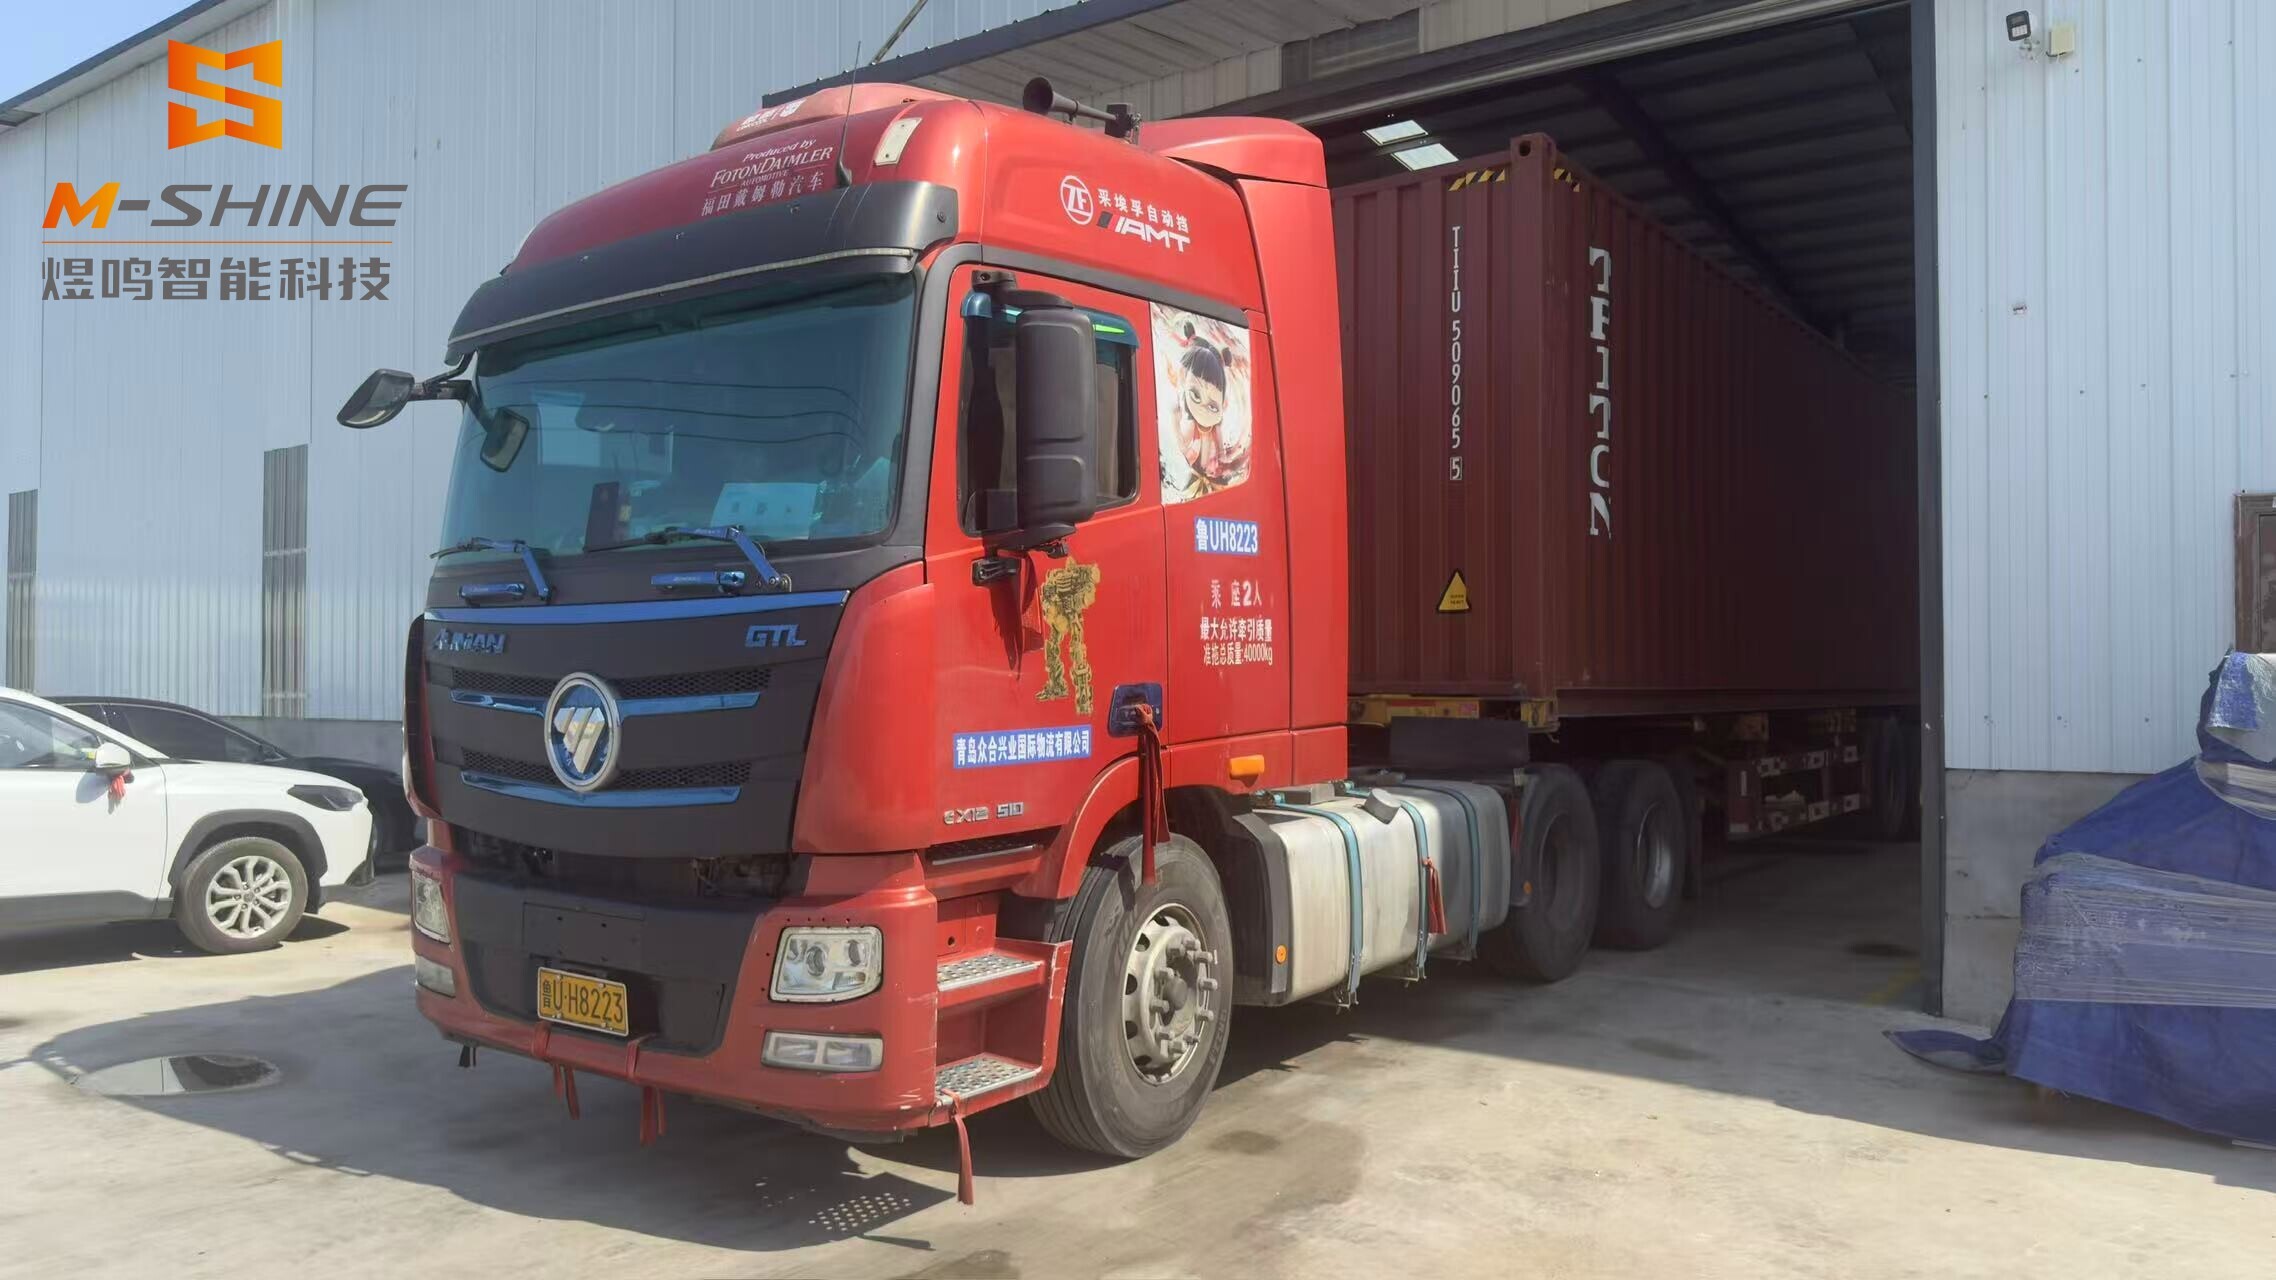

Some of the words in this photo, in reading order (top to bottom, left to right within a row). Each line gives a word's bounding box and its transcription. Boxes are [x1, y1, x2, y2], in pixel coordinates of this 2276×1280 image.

[743, 143, 799, 163] Produced
[801, 138, 817, 150] by
[740, 170, 790, 187] AUTOMOTIVE
[701, 171, 824, 217] 福田戴姆勒汽车
[1097, 188, 1189, 233] 采埃孚自动挡
[1451, 226, 1461, 313] TIIU
[1451, 320, 1461, 449] 509065
[1451, 458, 1462, 480] 5
[1196, 518, 1258, 553] 鲁UH8223
[744, 624, 808, 648] GTL
[1200, 616, 1273, 642] 最大允许牵引质量
[956, 730, 1090, 767] 青岛众合兴业国际物流有限公司
[997, 801, 1024, 819] 510
